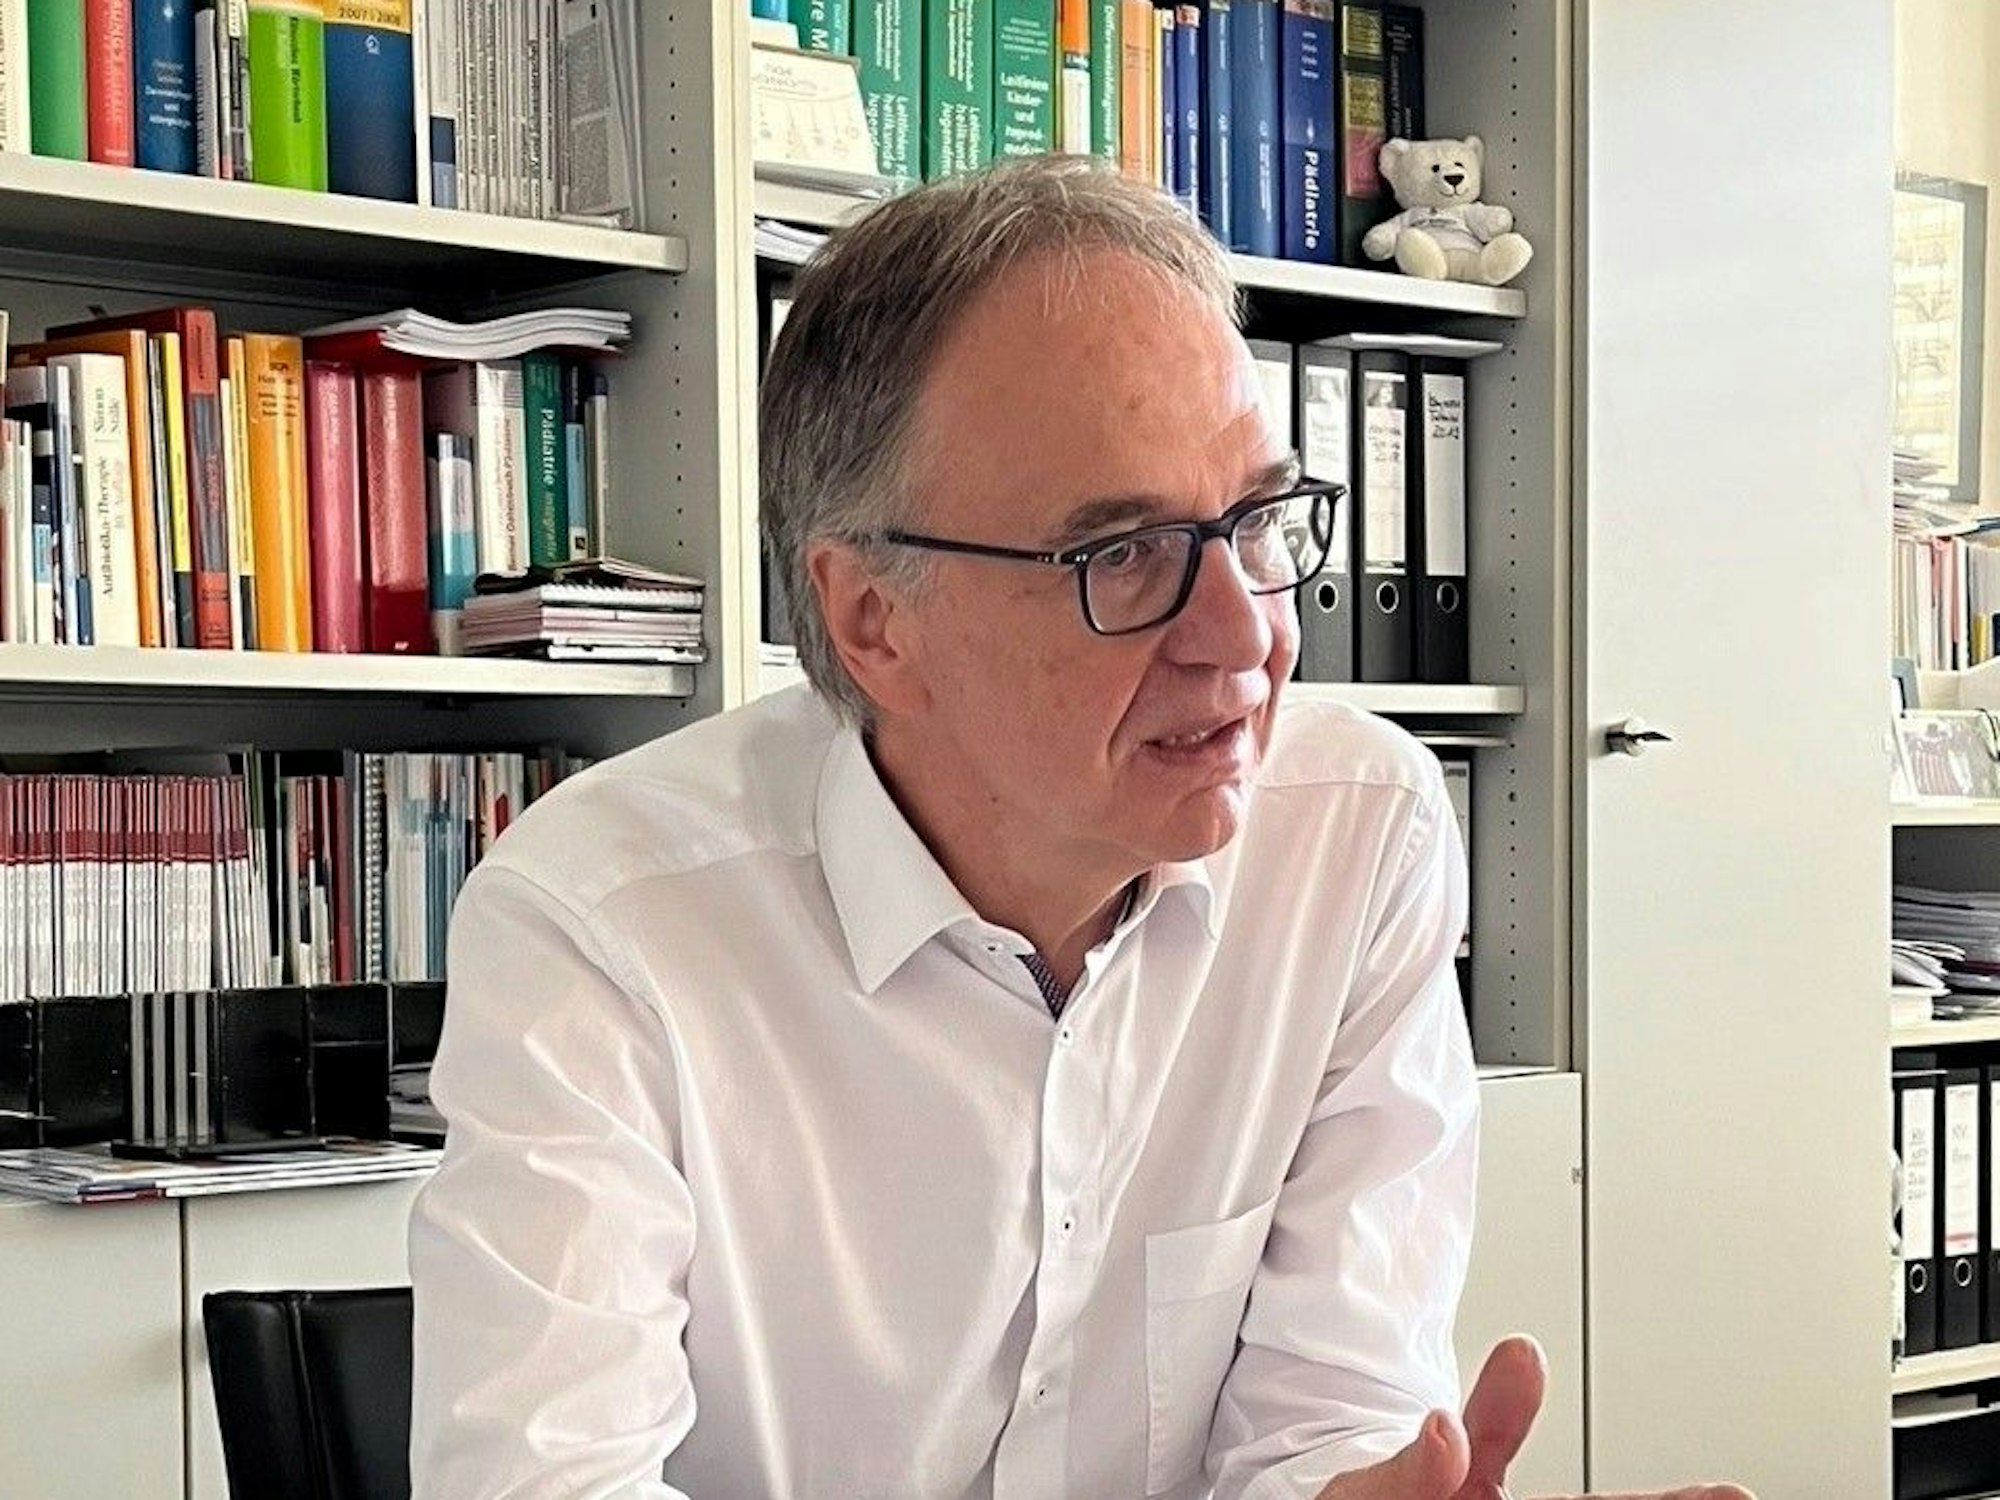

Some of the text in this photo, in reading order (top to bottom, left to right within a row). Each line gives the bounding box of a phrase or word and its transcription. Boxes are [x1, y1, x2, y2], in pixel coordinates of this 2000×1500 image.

[955, 103, 969, 171] heilkund
[1304, 150, 1321, 250] Pädiatrie
[540, 407, 556, 486] Pädiatrie
[96, 457, 114, 598] Antibiotika-Therapie
